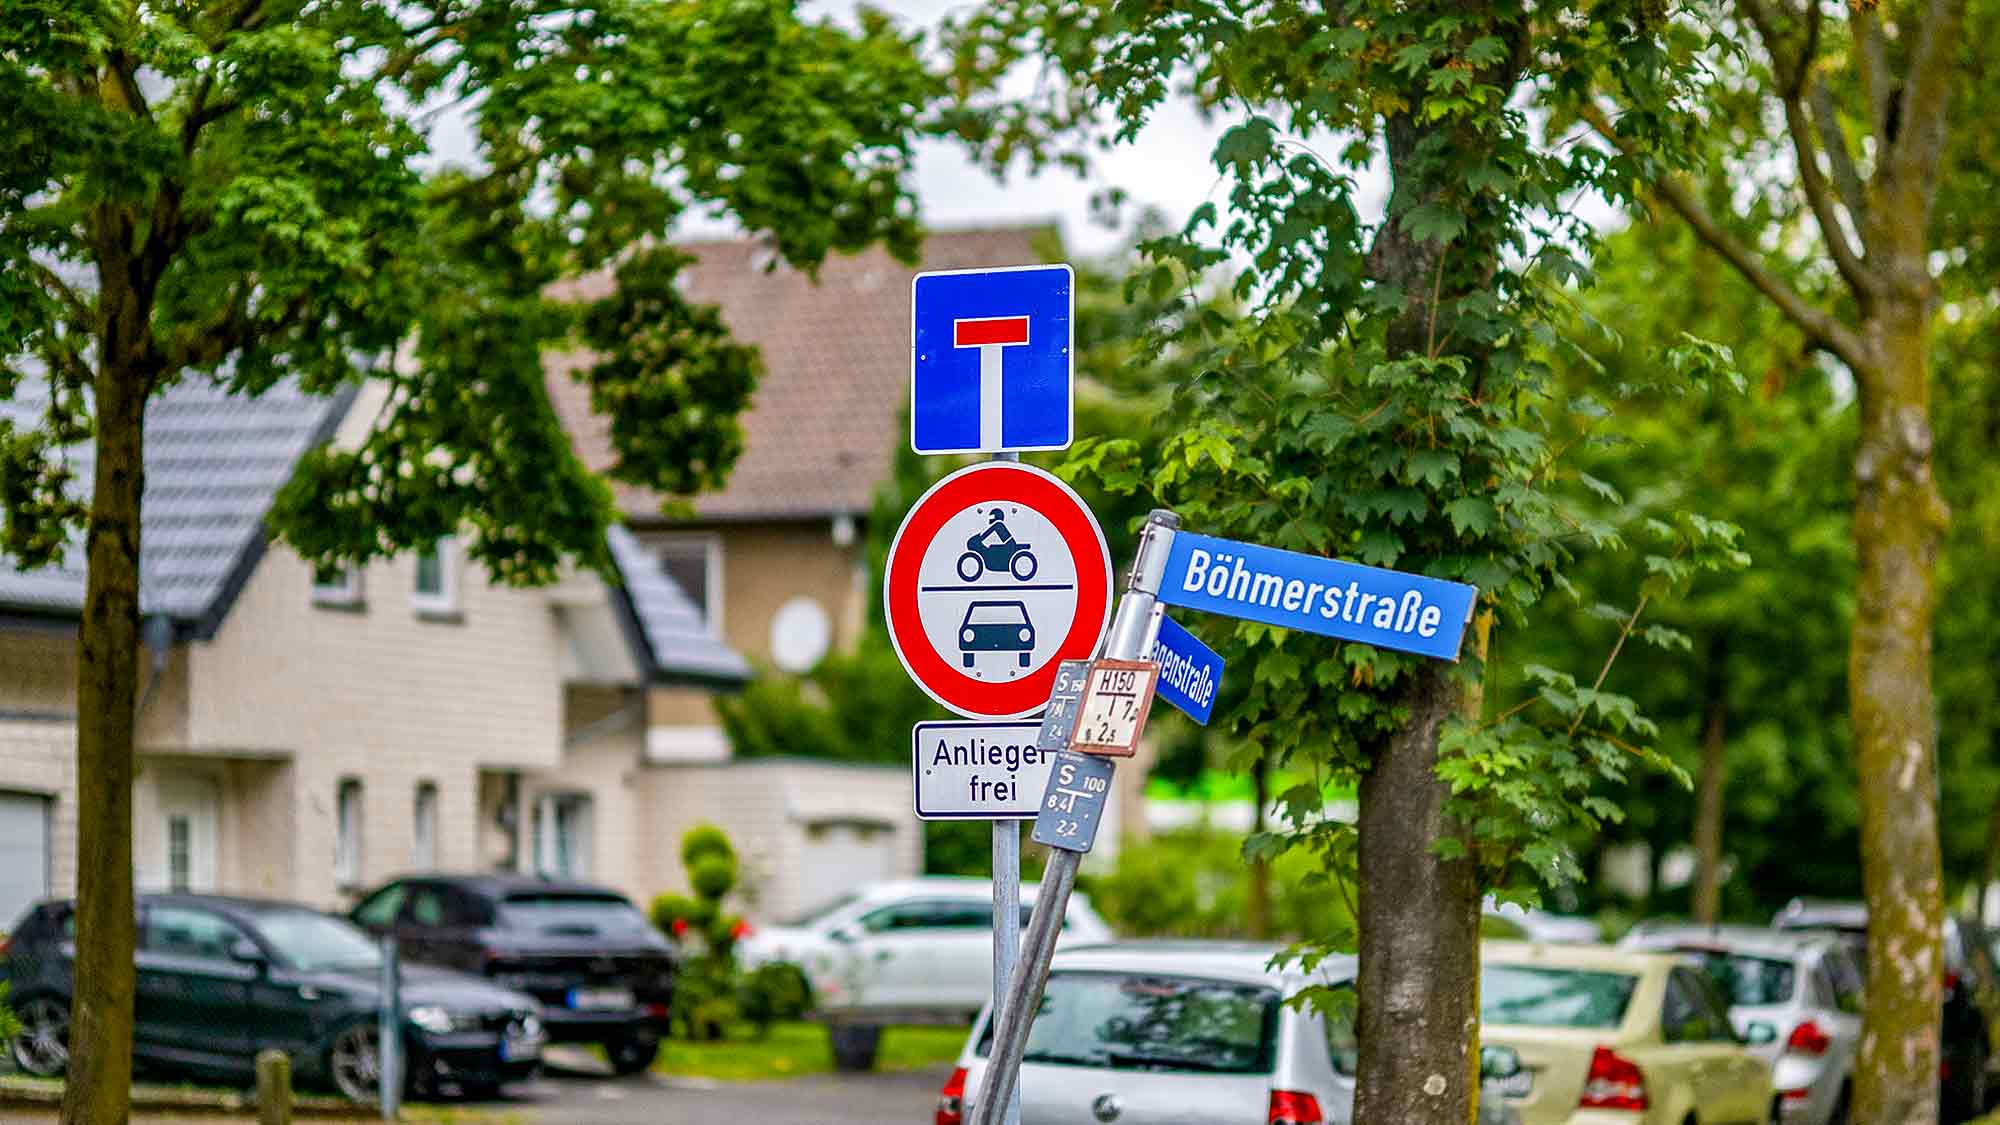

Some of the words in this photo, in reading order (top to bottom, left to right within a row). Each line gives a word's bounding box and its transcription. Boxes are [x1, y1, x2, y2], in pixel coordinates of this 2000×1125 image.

[1182, 549, 1441, 637] Böhmerstraße
[1056, 672, 1070, 692] S
[1099, 671, 1136, 691] H150
[1152, 640, 1213, 708] agenstraße
[969, 774, 1017, 801] frei
[1058, 764, 1076, 785] S
[1083, 775, 1107, 792] 100
